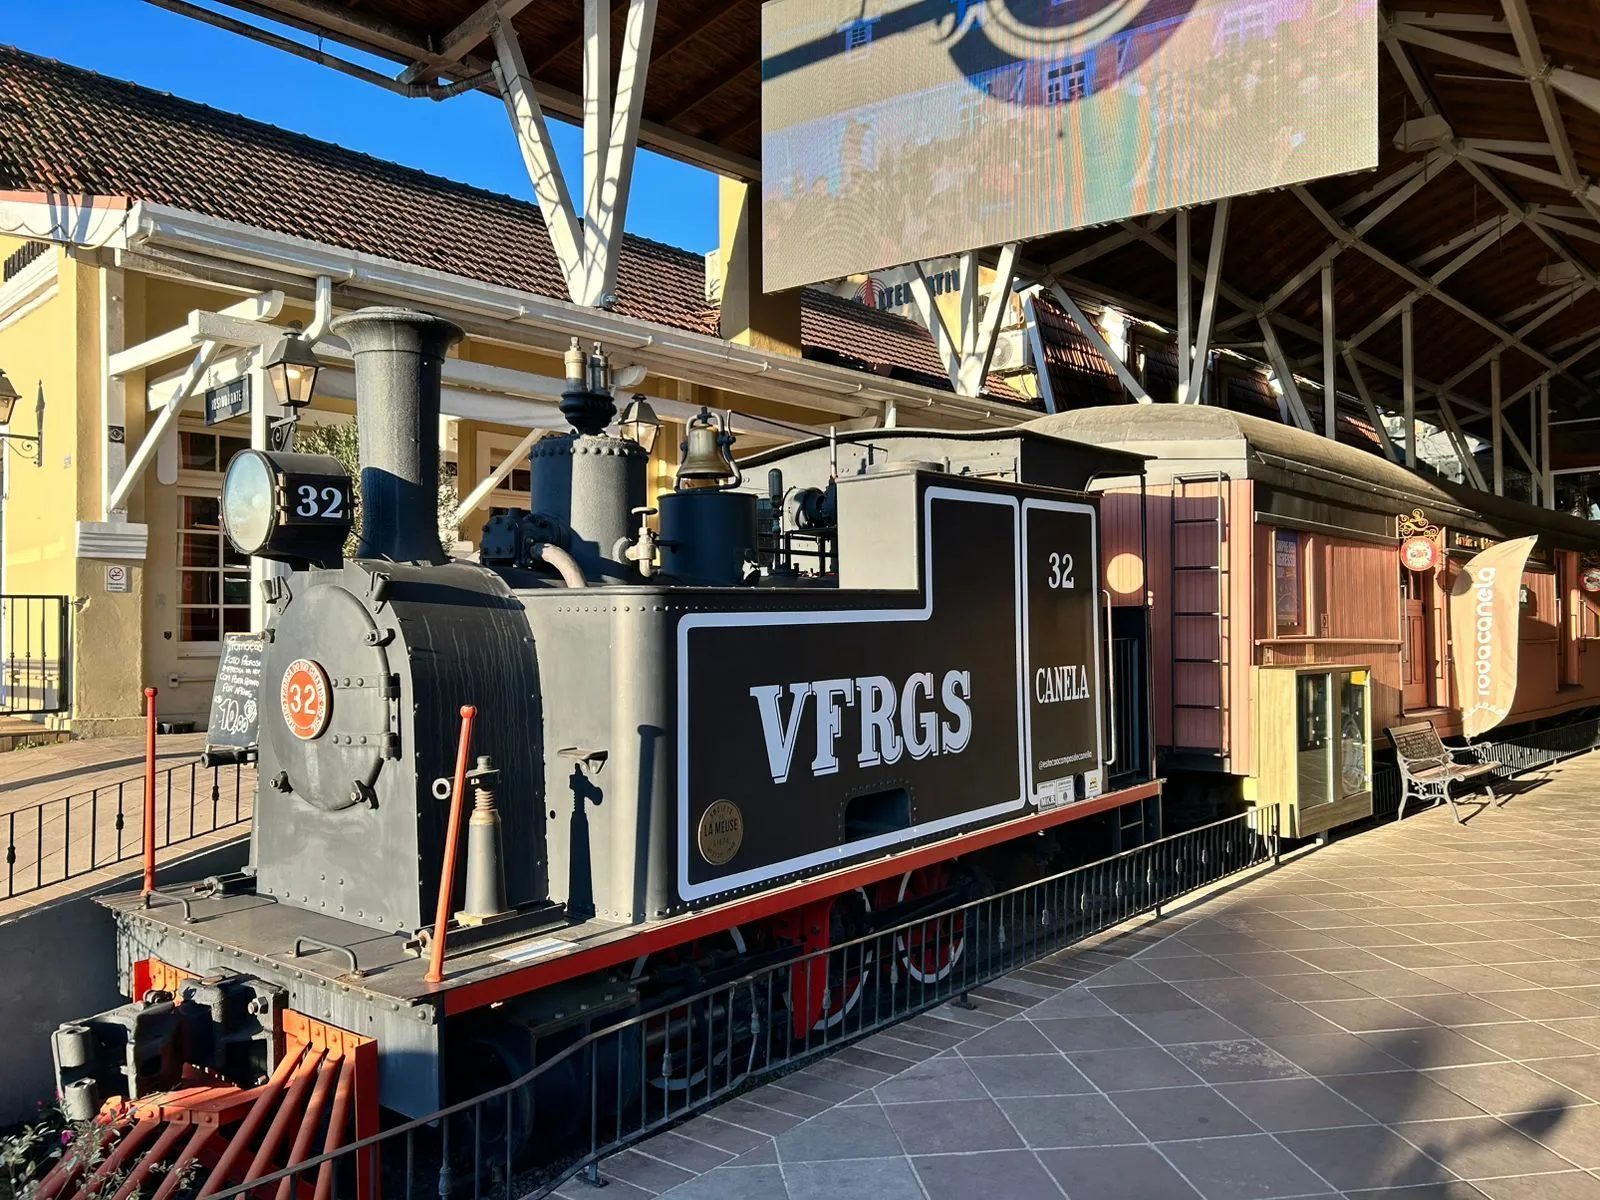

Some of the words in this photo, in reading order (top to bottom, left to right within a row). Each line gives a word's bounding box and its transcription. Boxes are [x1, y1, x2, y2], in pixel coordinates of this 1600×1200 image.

[296, 485, 343, 519] 32
[1048, 552, 1075, 589] 32
[1472, 567, 1497, 697] rodacanela
[289, 683, 317, 715] 32
[1035, 664, 1090, 704] CANELA
[749, 669, 973, 785] VFRGS
[703, 823, 713, 837] LA
[714, 818, 739, 836] MEUSE
